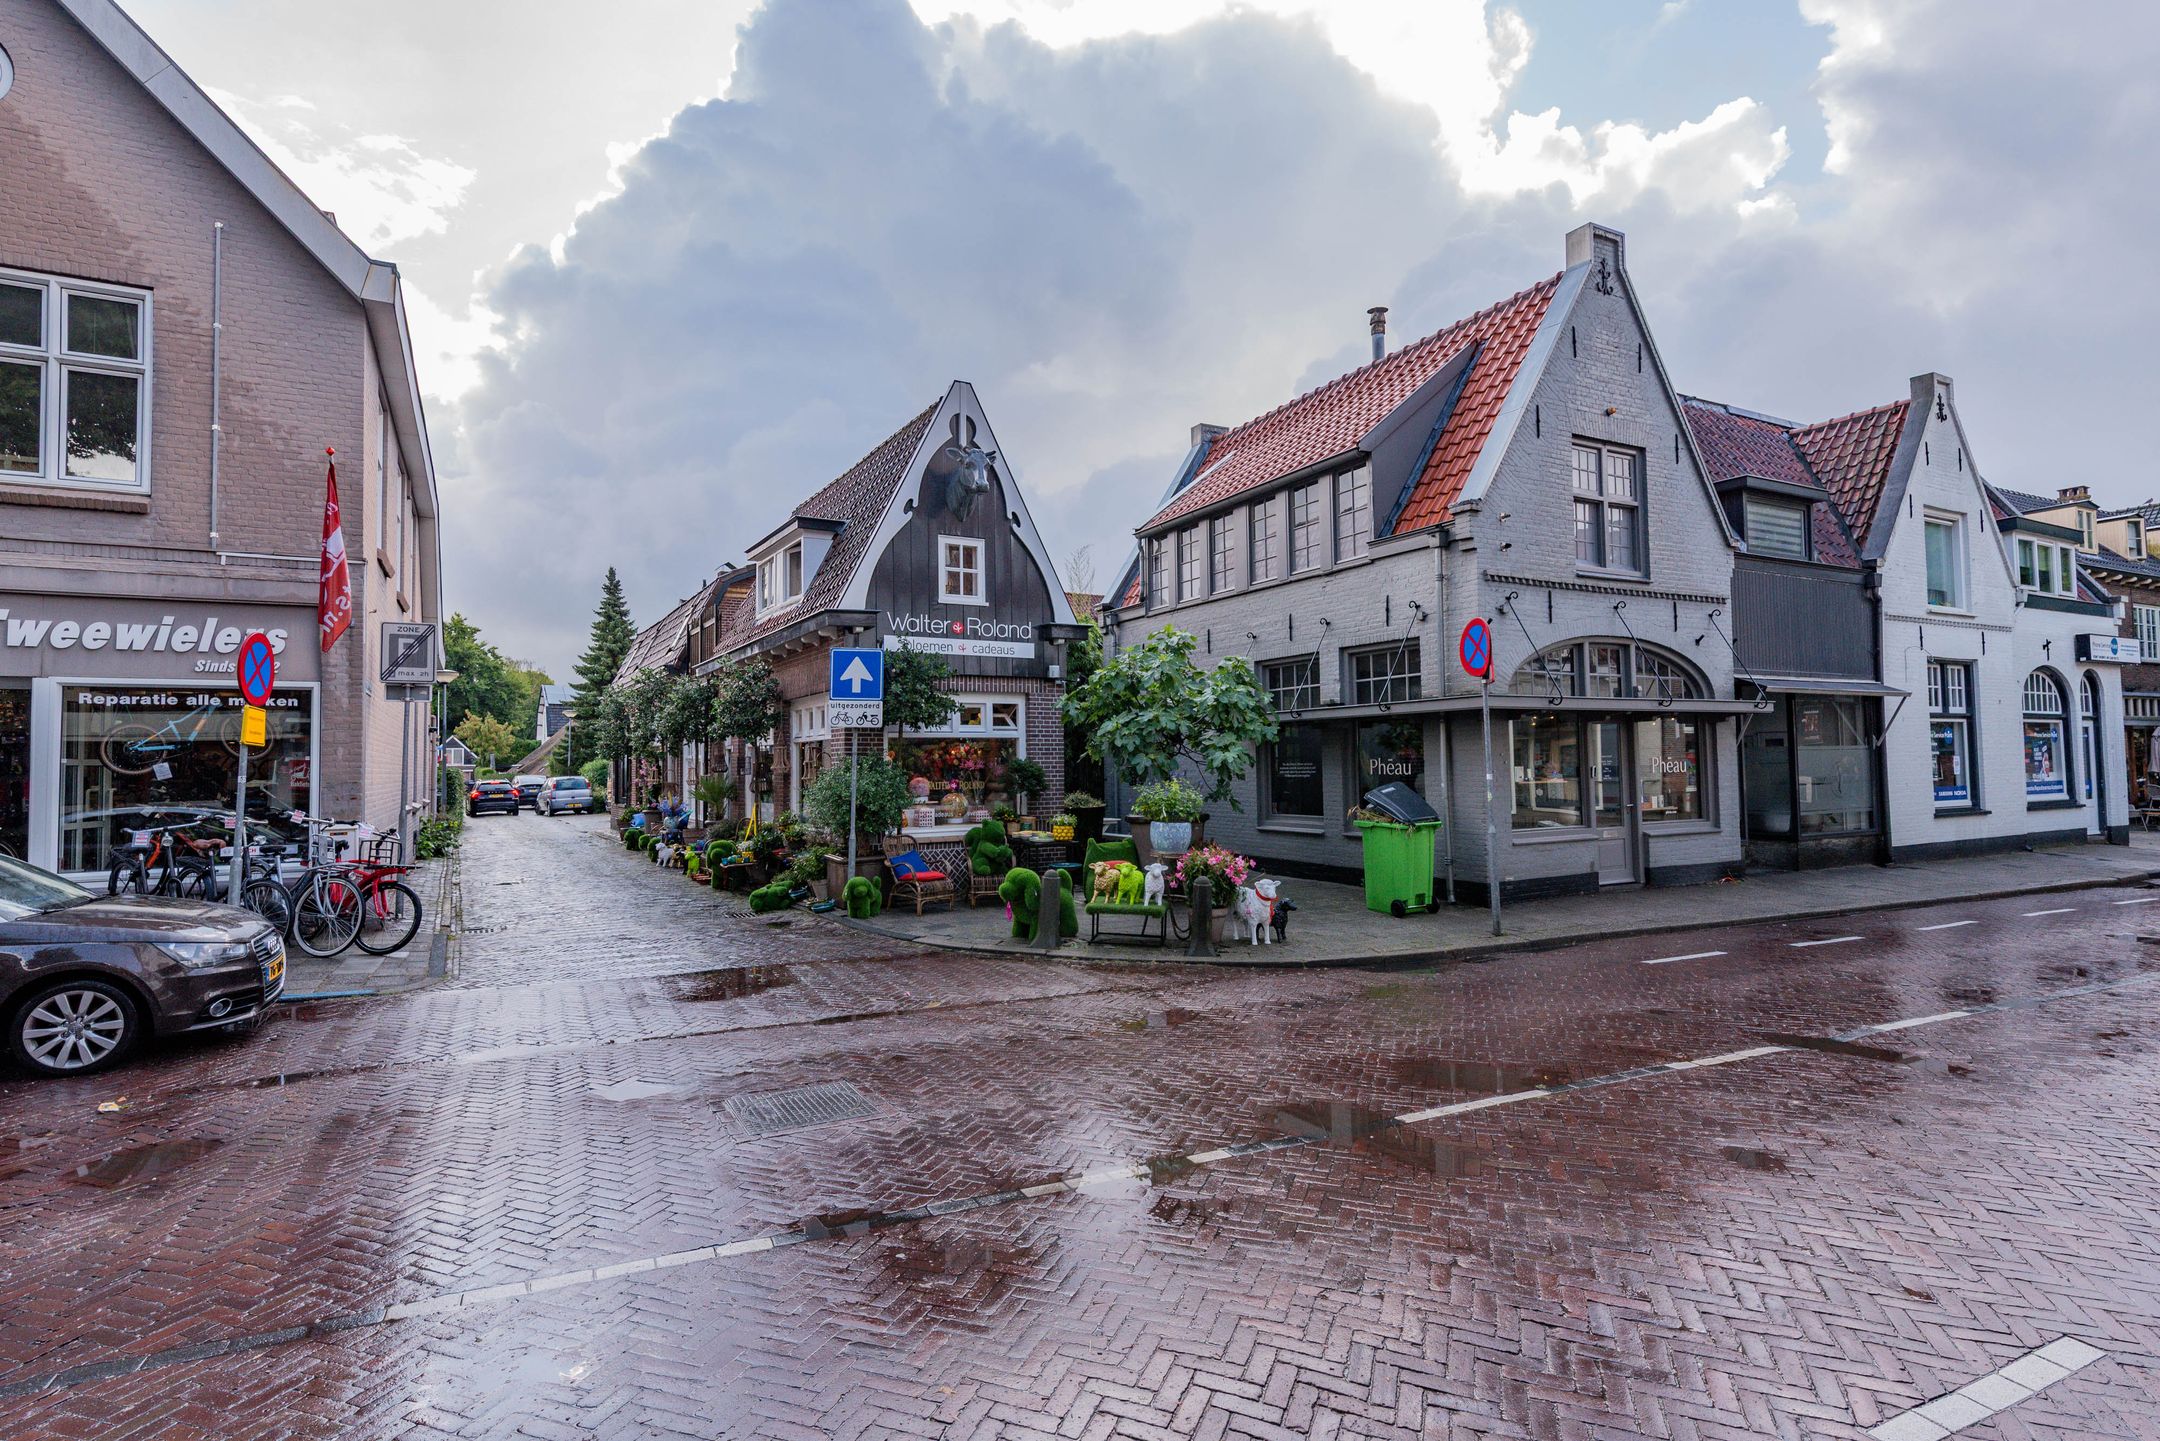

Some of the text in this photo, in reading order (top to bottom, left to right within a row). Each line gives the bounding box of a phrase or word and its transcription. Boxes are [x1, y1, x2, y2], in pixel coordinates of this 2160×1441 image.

[0, 609, 288, 655] weewieles
[887, 612, 1032, 639] Walter Roland
[972, 645, 1015, 656] cadeaus
[195, 659, 237, 674] Sinds
[78, 692, 299, 708] Reparatie alle mken
[830, 702, 880, 710] uitgezonderd
